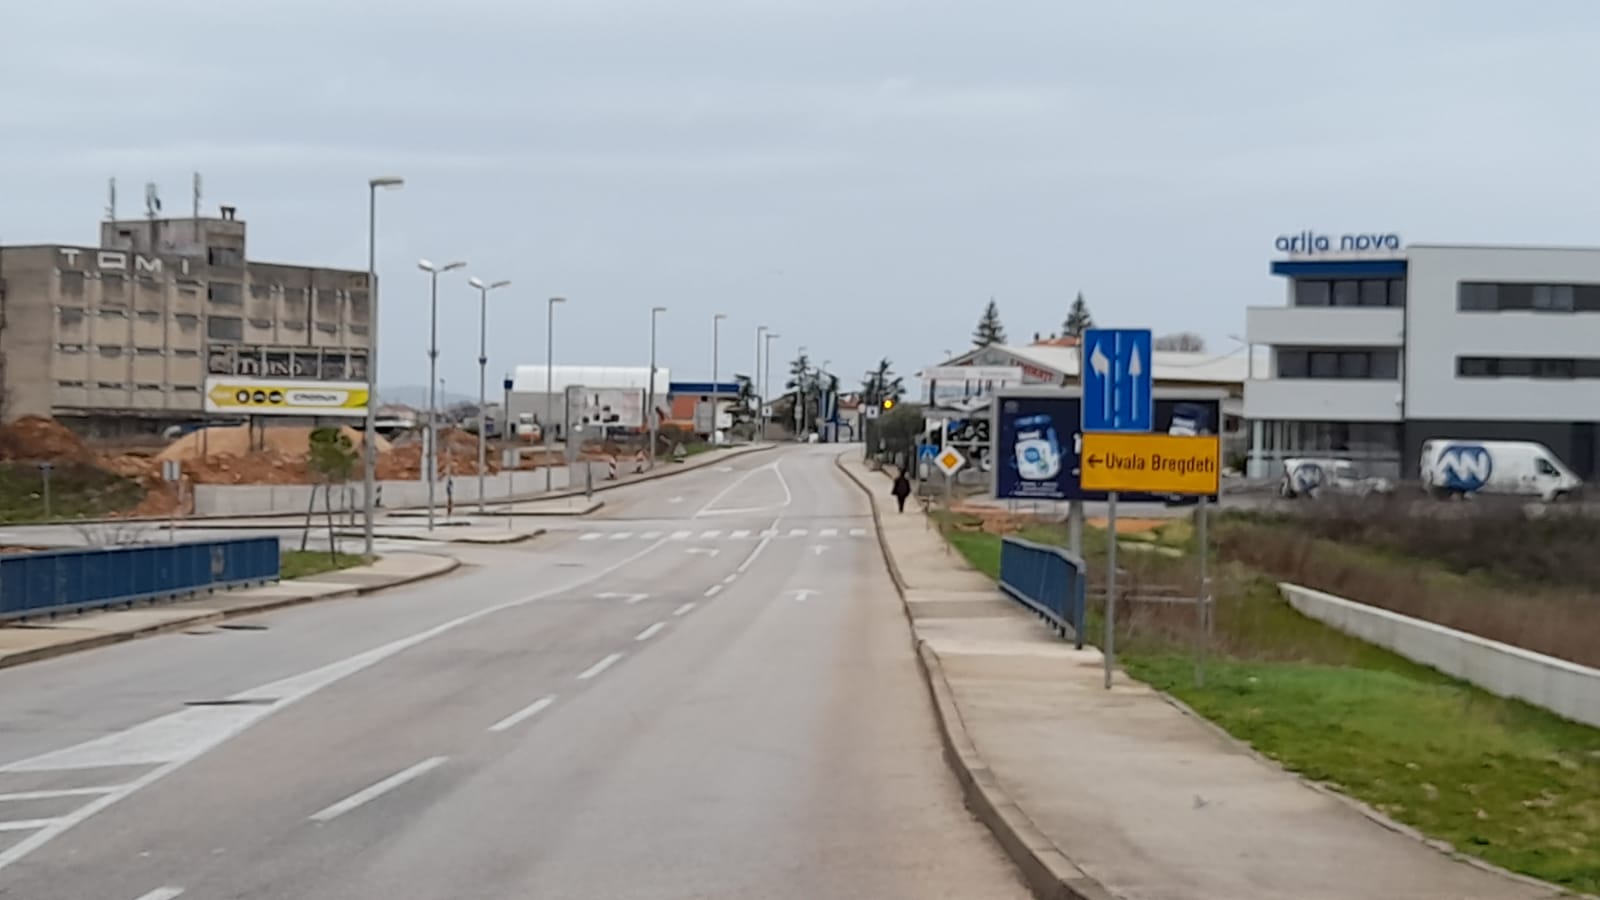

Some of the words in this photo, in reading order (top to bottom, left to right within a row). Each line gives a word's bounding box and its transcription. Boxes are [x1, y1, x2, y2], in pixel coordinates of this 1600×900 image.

[1340, 234, 1399, 251] nova
[60, 248, 190, 275] TOMI
[1105, 452, 1145, 471] Uvala
[1151, 453, 1214, 477] Bregdeti
